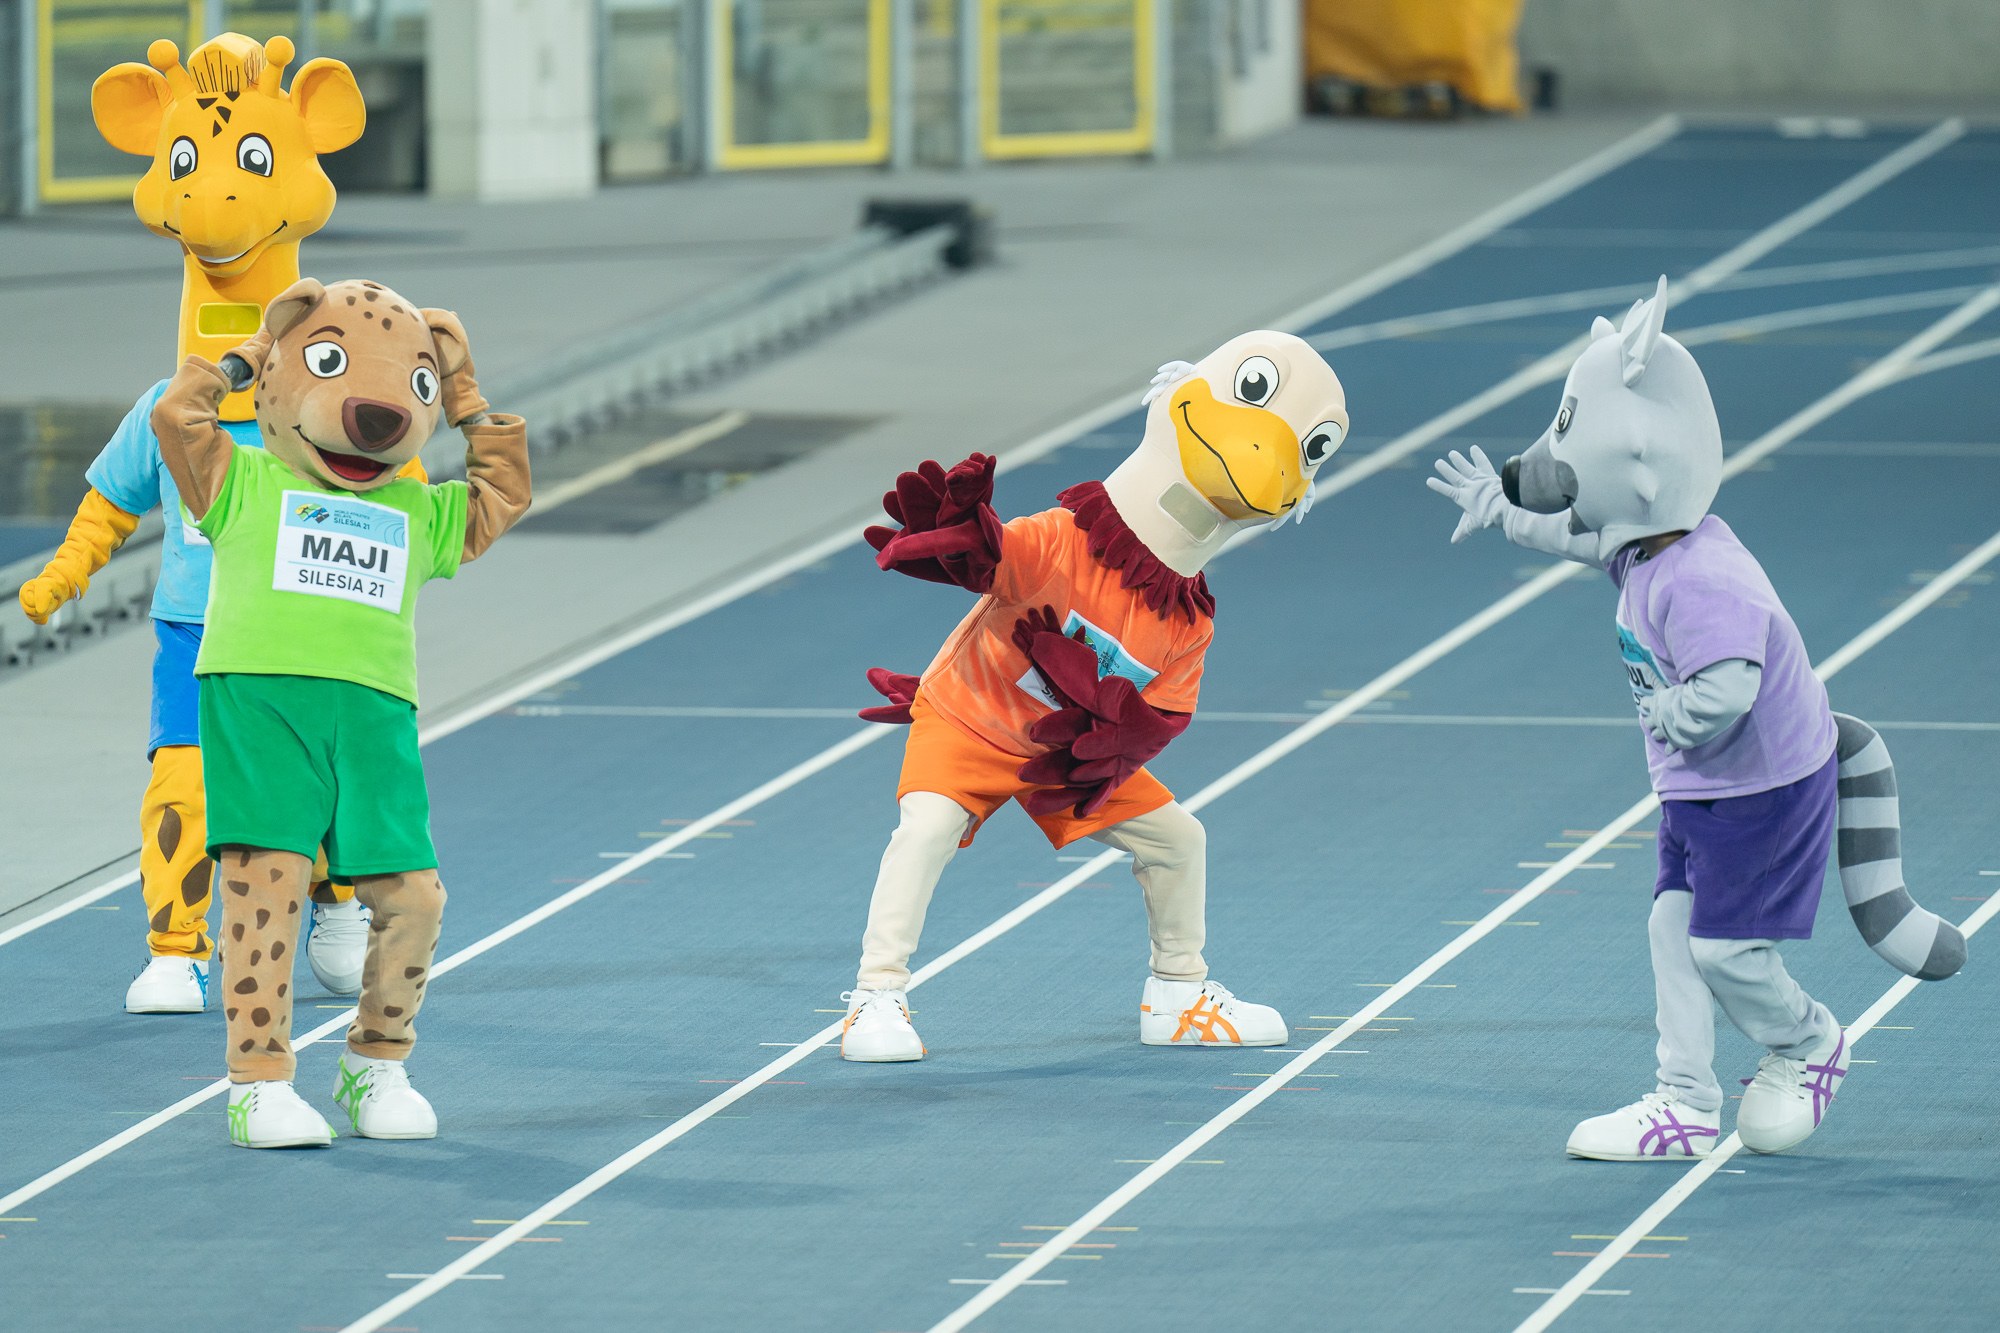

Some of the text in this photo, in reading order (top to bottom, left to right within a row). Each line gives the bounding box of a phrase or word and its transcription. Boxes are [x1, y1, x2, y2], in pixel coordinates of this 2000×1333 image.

[334, 518, 370, 530] SILESIA 21
[302, 534, 388, 574] MAJI
[298, 569, 385, 598] SILESIA 21
[1107, 667, 1116, 675] 21
